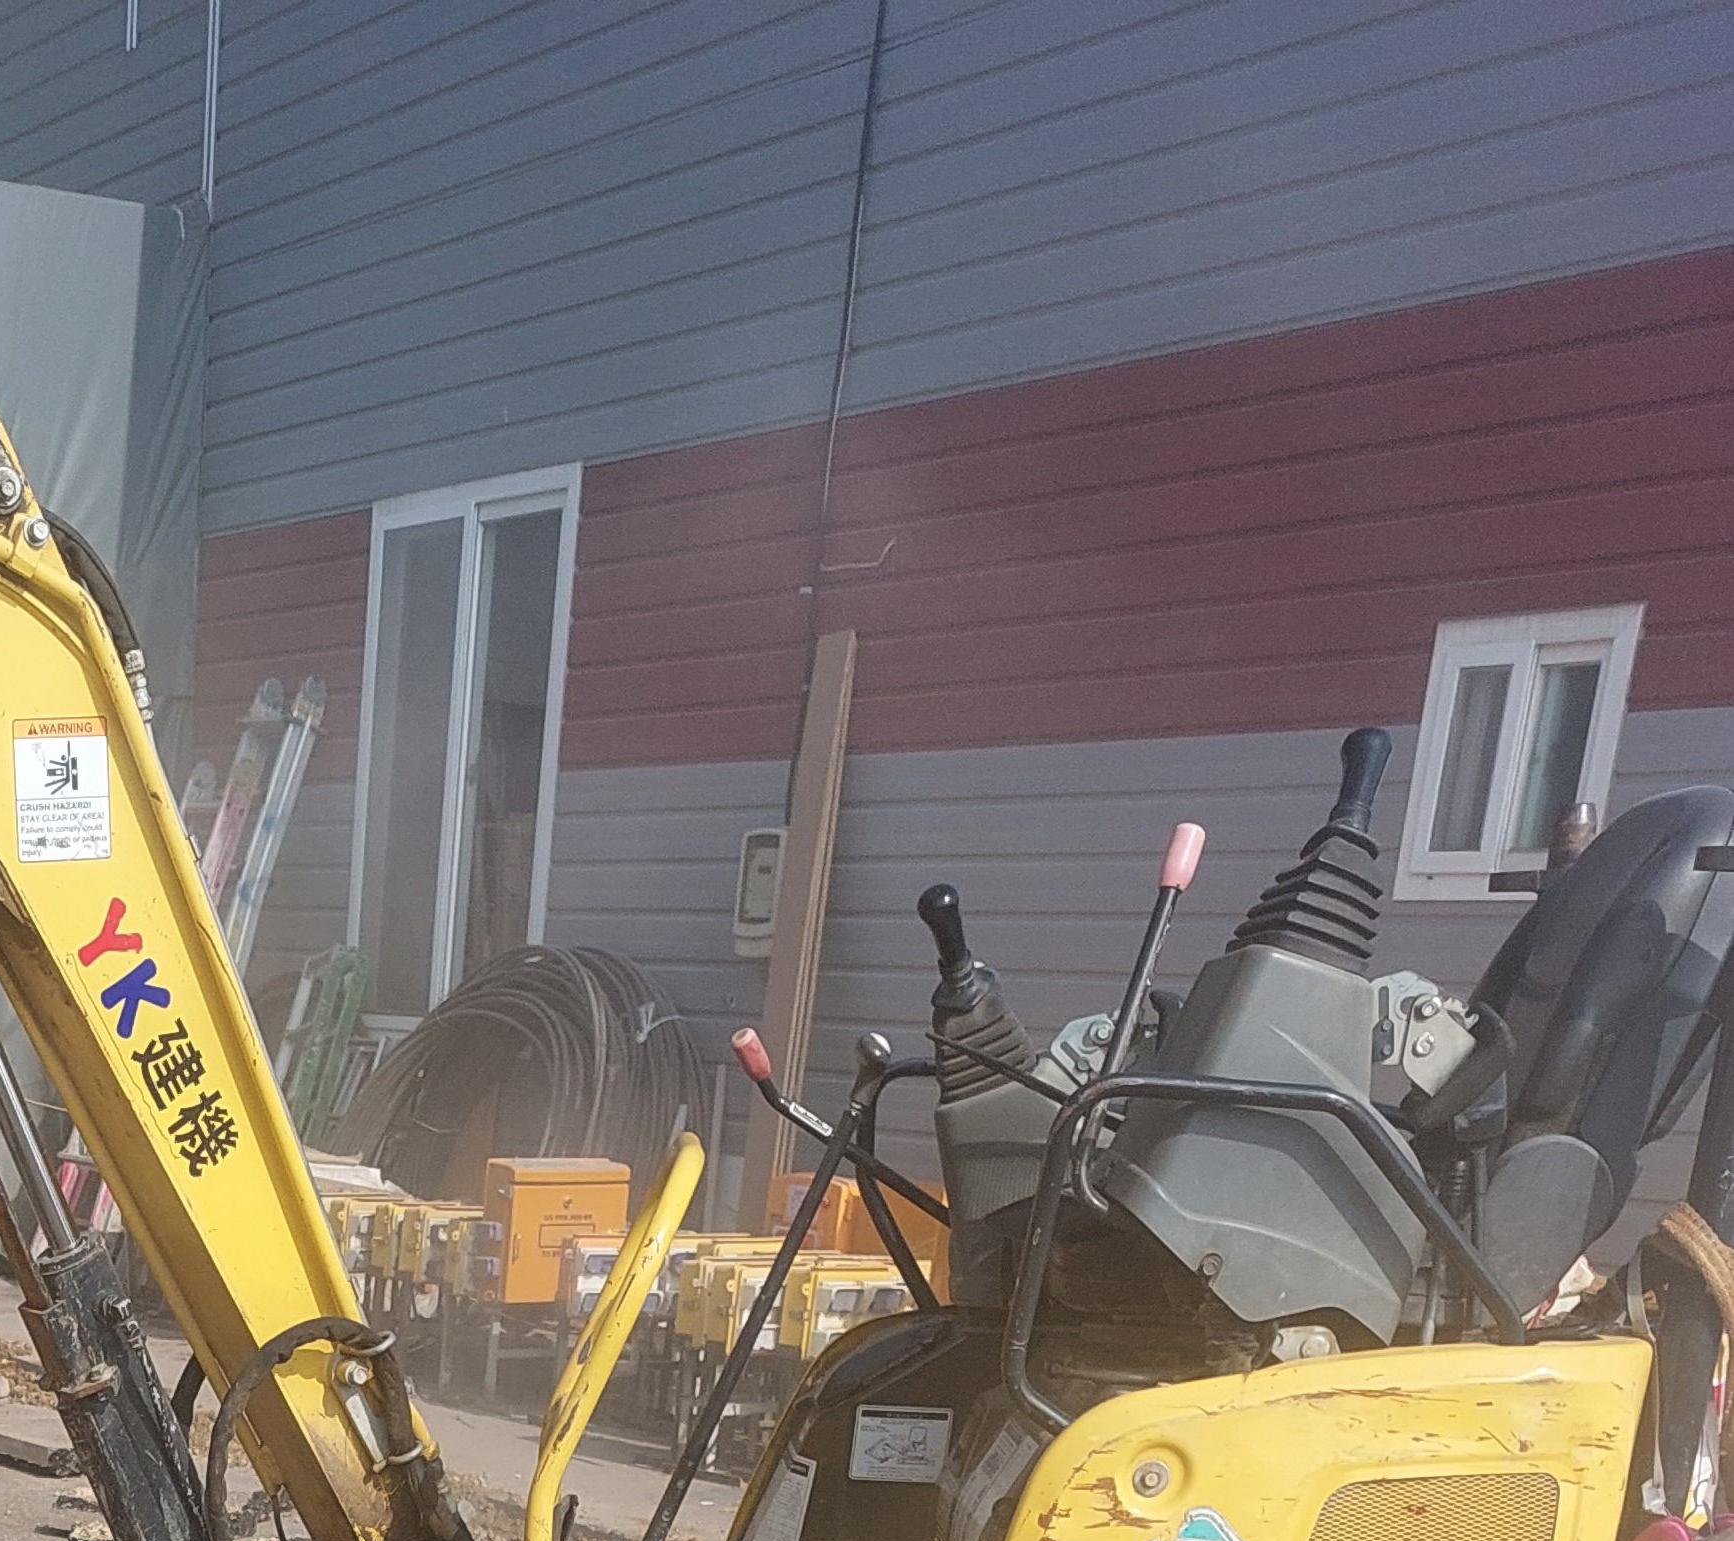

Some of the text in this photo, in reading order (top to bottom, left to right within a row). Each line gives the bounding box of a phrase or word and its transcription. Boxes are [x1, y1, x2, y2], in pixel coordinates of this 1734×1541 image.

[39, 722, 93, 735] WARNING
[20, 801, 92, 811] CRUSH HAZARD!
[21, 814, 40, 823] STAY
[42, 812, 68, 821] CLEAR
